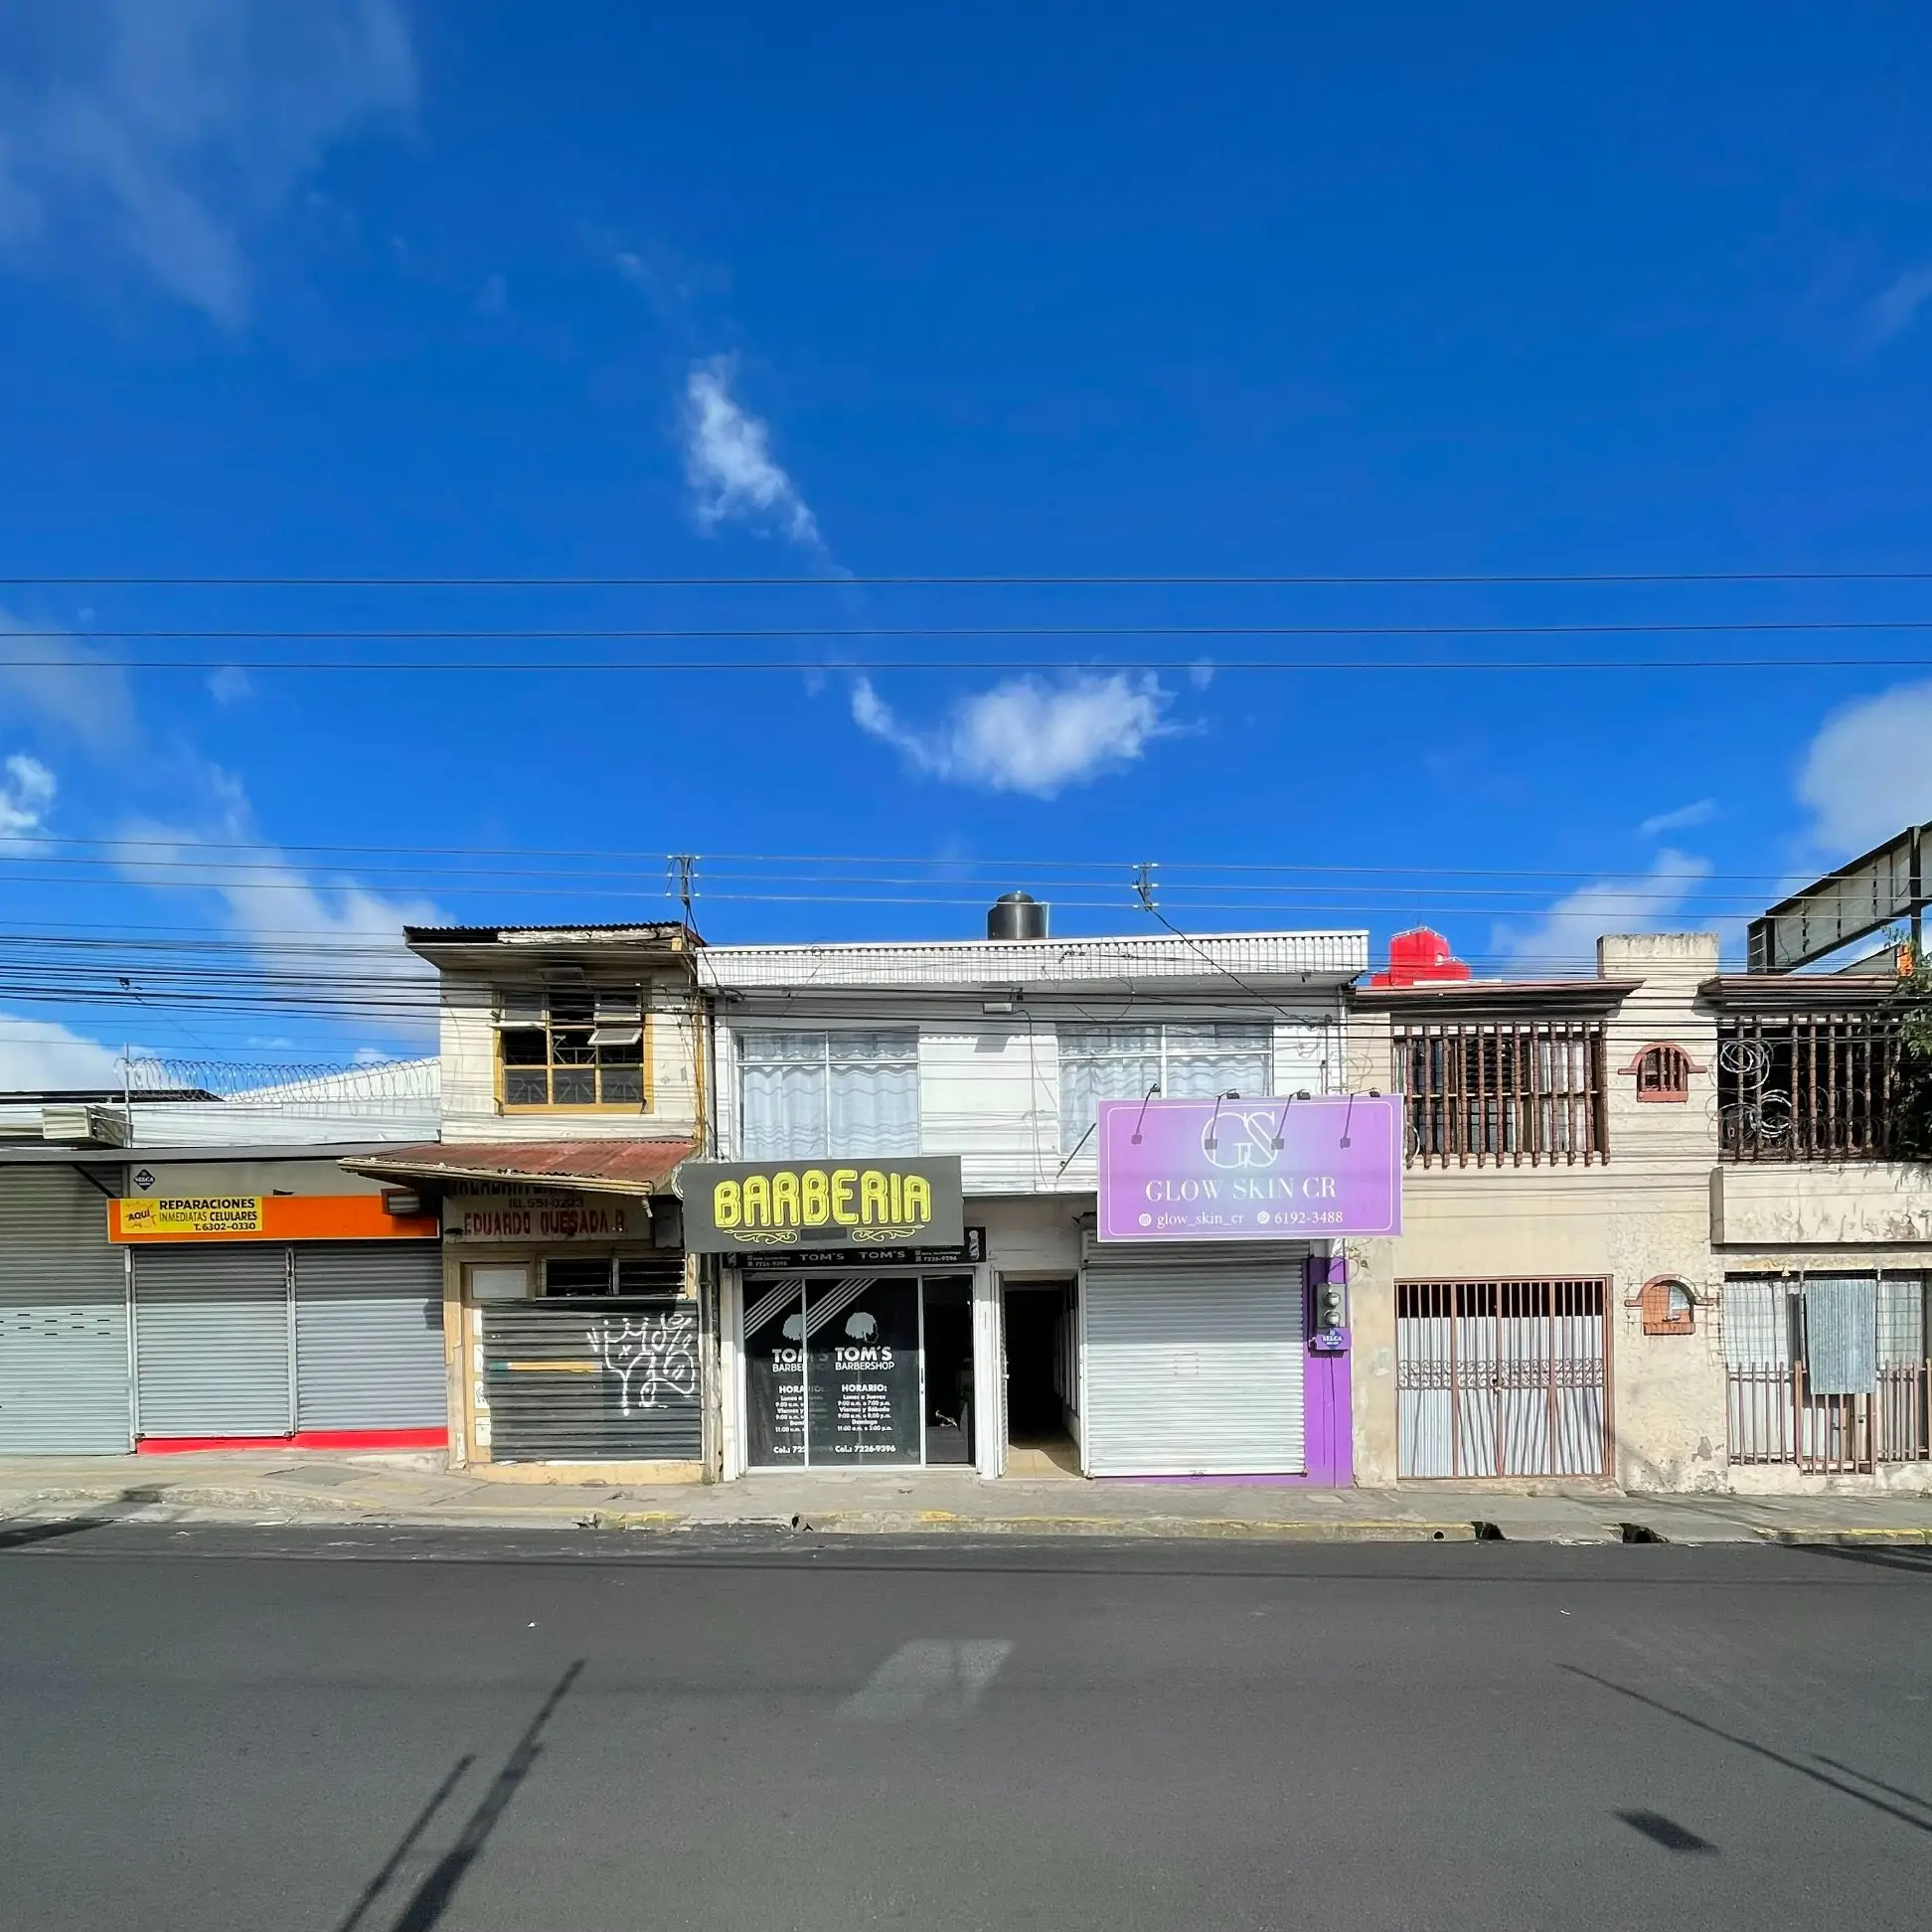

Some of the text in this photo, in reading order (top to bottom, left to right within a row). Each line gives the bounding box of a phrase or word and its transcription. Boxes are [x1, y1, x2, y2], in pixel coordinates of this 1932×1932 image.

[1145, 1177, 1337, 1202] GLOW SKIN CR
[159, 1199, 255, 1210] REPARACIONES
[714, 1169, 931, 1227] BARBERIA
[159, 1210, 257, 1221] INMEDIATAS CELULARES
[464, 1211, 531, 1235] EDUARDO
[1156, 1211, 1344, 1229] glow_skin_cr 6192-3488
[835, 1347, 892, 1362] TOM'S
[835, 1361, 894, 1370] BARBERSHOP
[842, 1383, 887, 1392] HORARIO:
